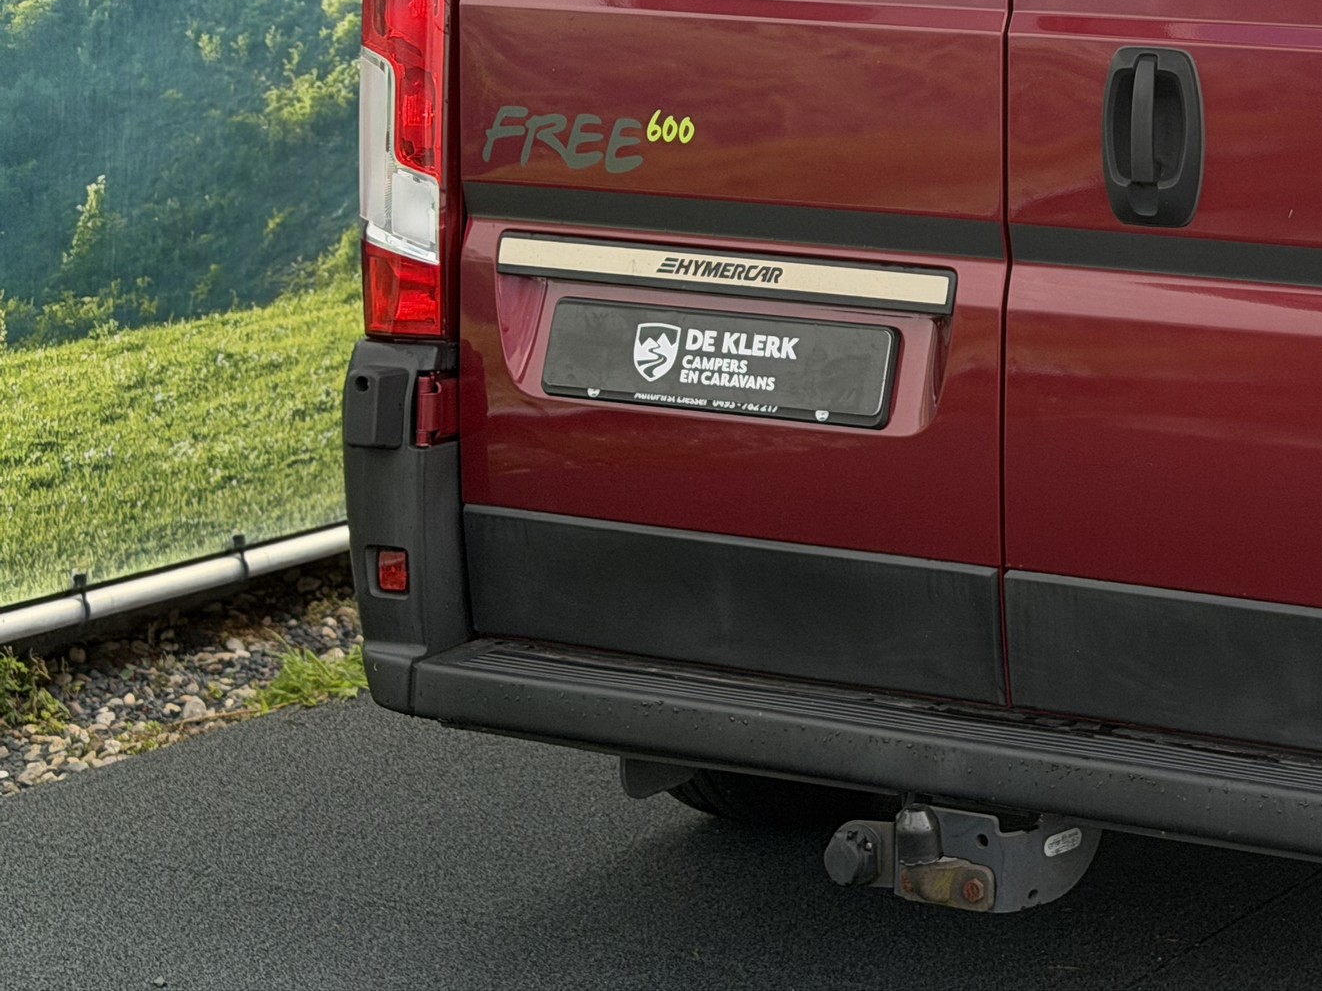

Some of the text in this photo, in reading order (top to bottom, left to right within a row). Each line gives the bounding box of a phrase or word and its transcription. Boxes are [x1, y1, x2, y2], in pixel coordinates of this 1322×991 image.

[482, 105, 696, 174] FREE 600
[673, 258, 784, 284] HYMERCAR
[685, 328, 800, 360] DE KLERK
[681, 354, 749, 374] CAMPERS
[679, 369, 776, 391] EN CARAVANS
